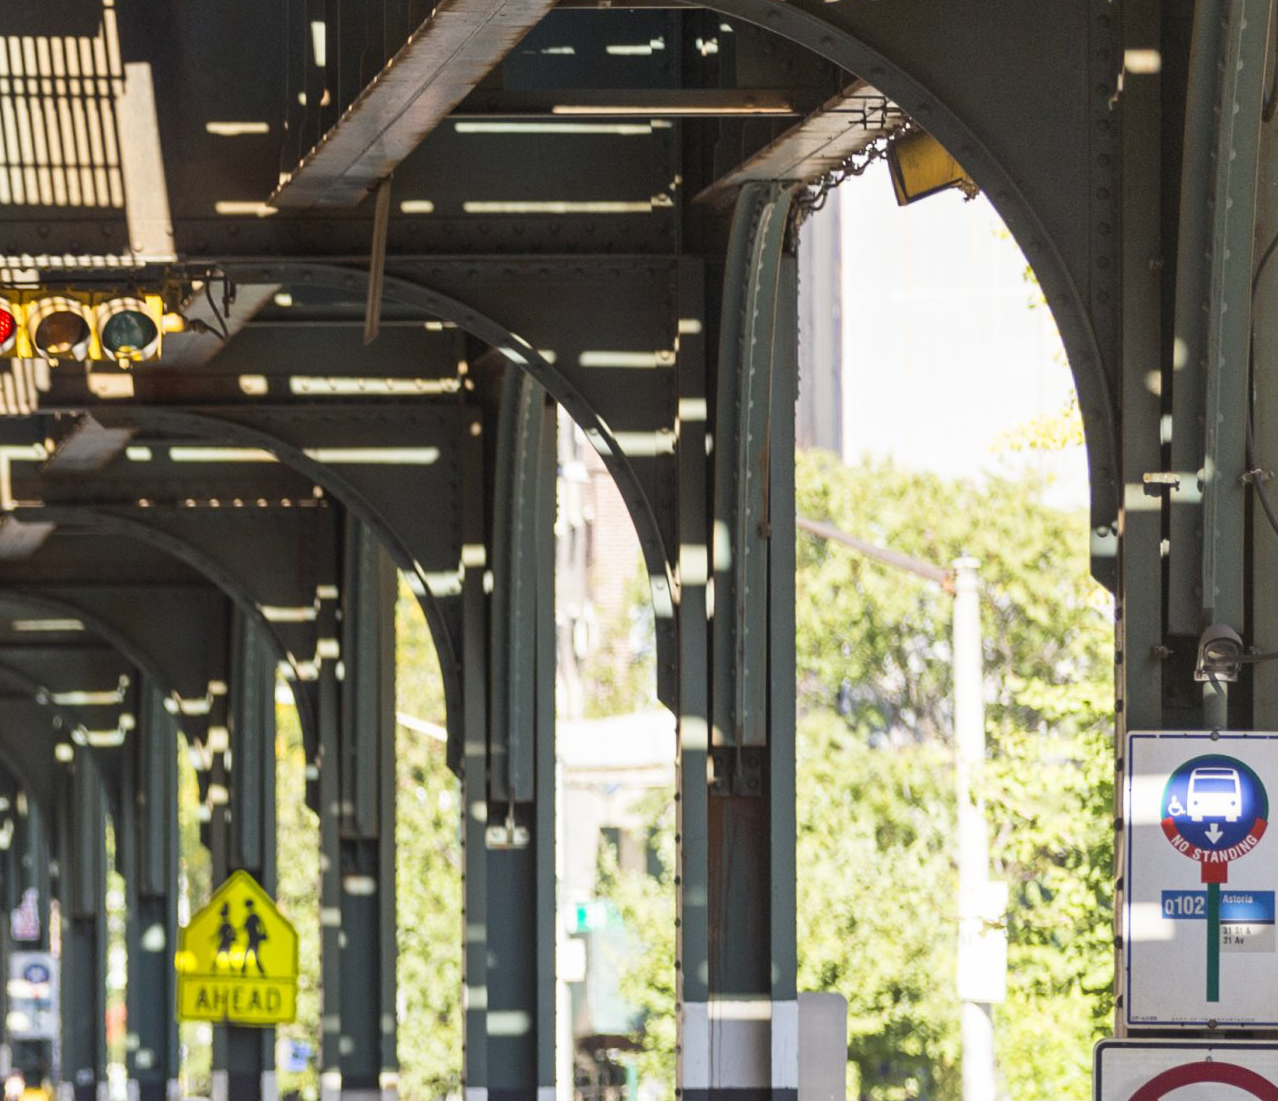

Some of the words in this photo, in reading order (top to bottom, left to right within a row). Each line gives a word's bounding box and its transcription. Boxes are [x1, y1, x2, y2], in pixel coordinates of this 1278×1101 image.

[1171, 834, 1189, 852] NO
[1192, 834, 1258, 863] STANDING
[1165, 896, 1205, 915] Q102
[1222, 894, 1253, 904] Astoria
[1222, 936, 1232, 945] 31
[1234, 936, 1245, 945] Av
[195, 985, 282, 1015] AHEAD
